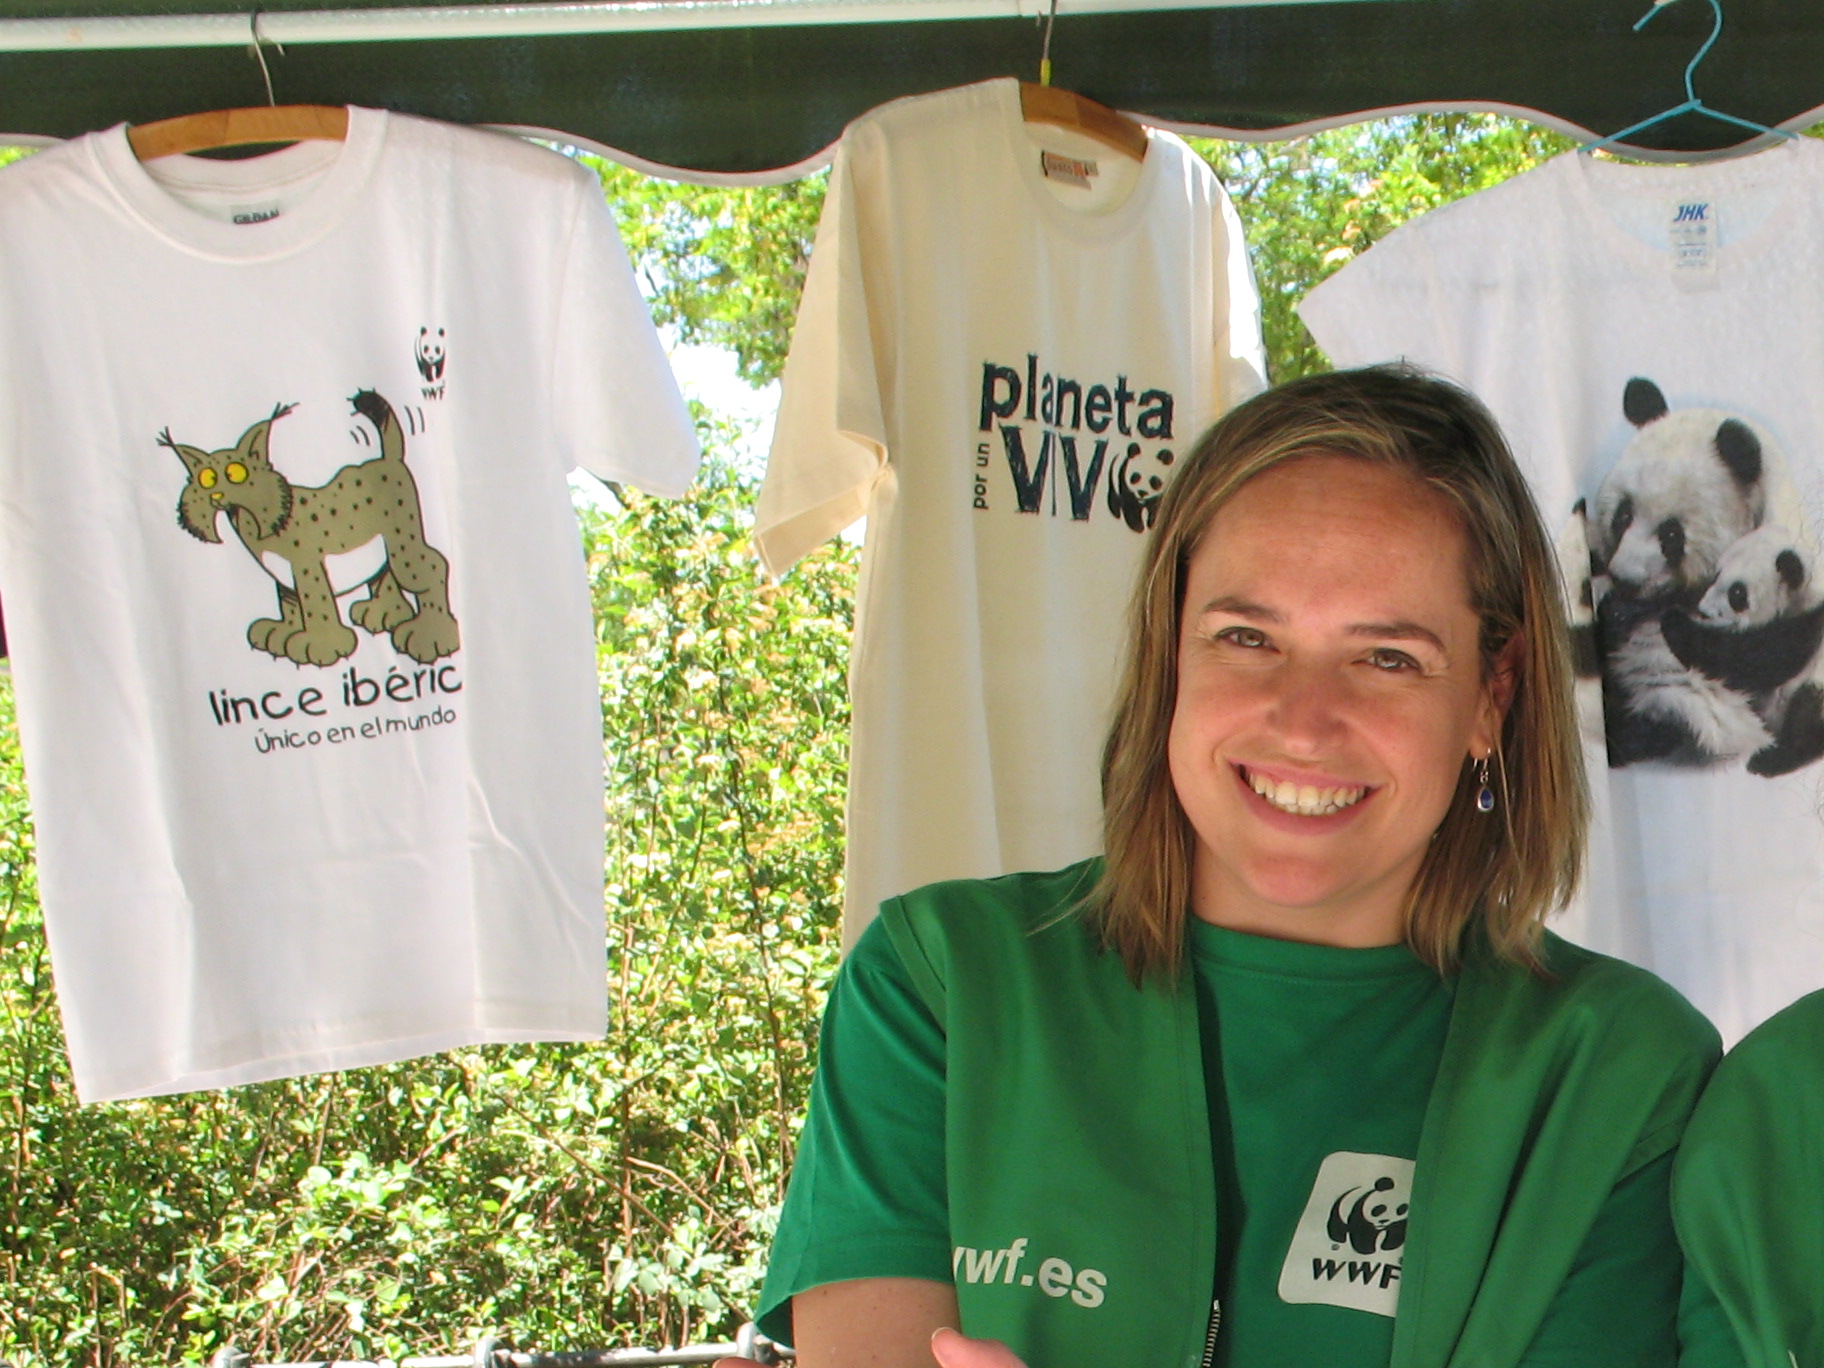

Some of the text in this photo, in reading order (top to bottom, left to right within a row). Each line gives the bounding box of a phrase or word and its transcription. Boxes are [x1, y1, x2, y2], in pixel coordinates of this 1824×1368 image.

[1672, 203, 1709, 222] JHK
[980, 352, 1174, 440] planeta
[973, 442, 990, 510] por un
[208, 665, 462, 726] lince ibéric
[254, 706, 456, 753] Único en el mundo
[1312, 1257, 1402, 1289] WWF
